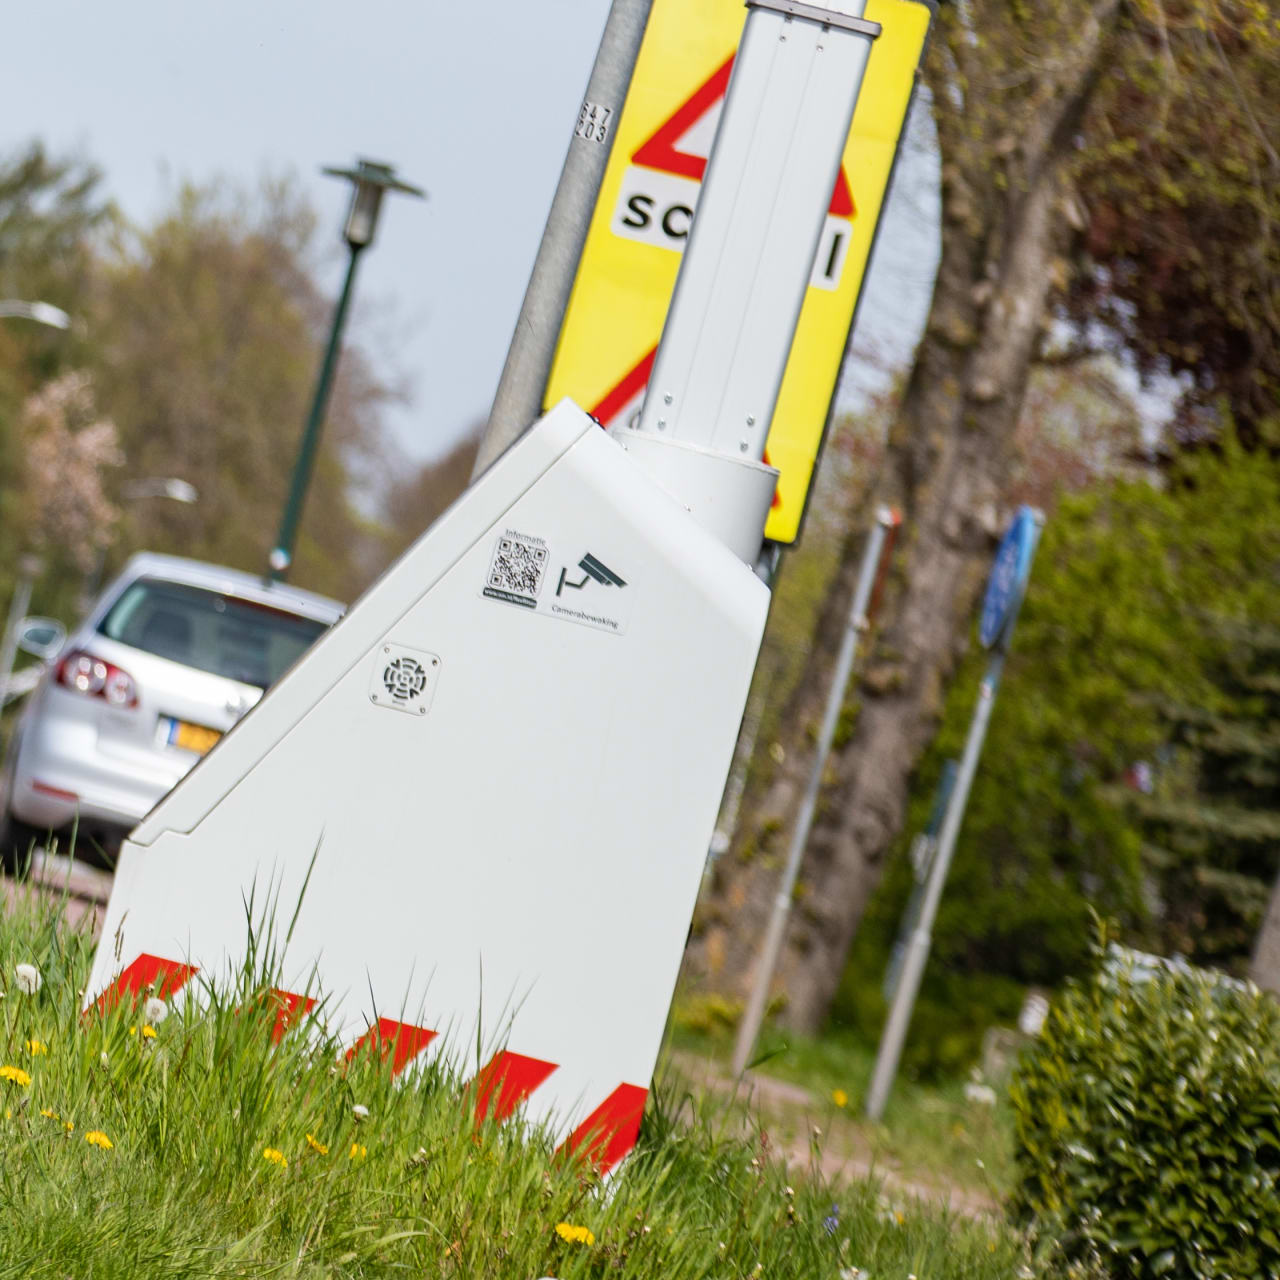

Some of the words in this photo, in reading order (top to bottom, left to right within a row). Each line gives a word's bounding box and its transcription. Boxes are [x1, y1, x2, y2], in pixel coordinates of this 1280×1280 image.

[580, 102, 611, 125] 647
[575, 119, 607, 143] 203
[551, 604, 619, 631] Camerabewaking
